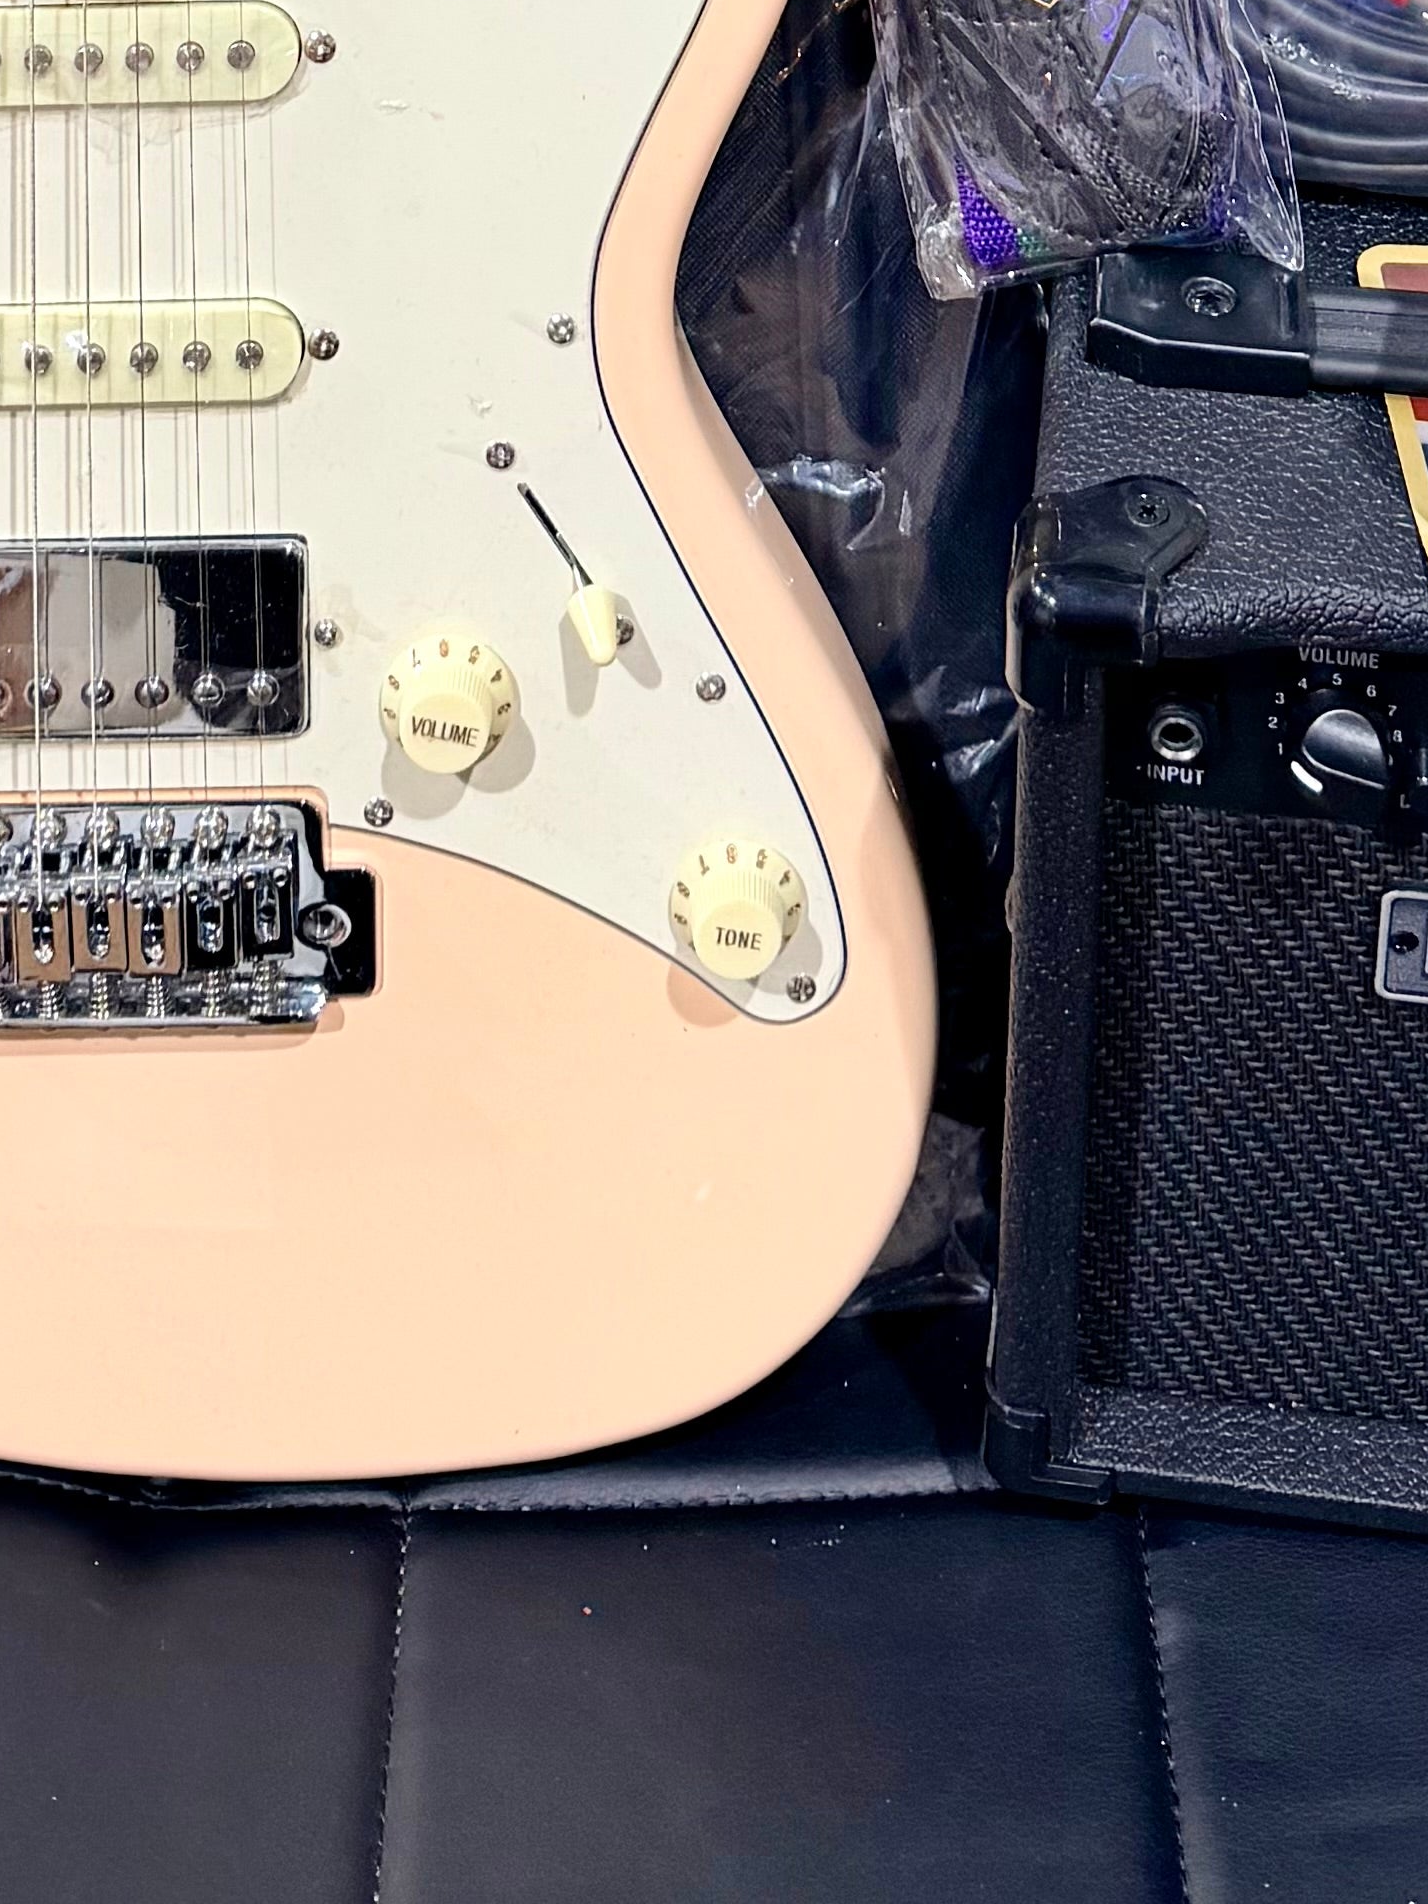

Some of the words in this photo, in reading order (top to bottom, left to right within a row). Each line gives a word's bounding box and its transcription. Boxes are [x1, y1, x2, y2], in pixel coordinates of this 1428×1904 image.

[1298, 645, 1380, 670] VOLUME
[411, 714, 481, 748] VOLUME
[1147, 763, 1205, 787] INPUT
[714, 925, 763, 952] TONE
